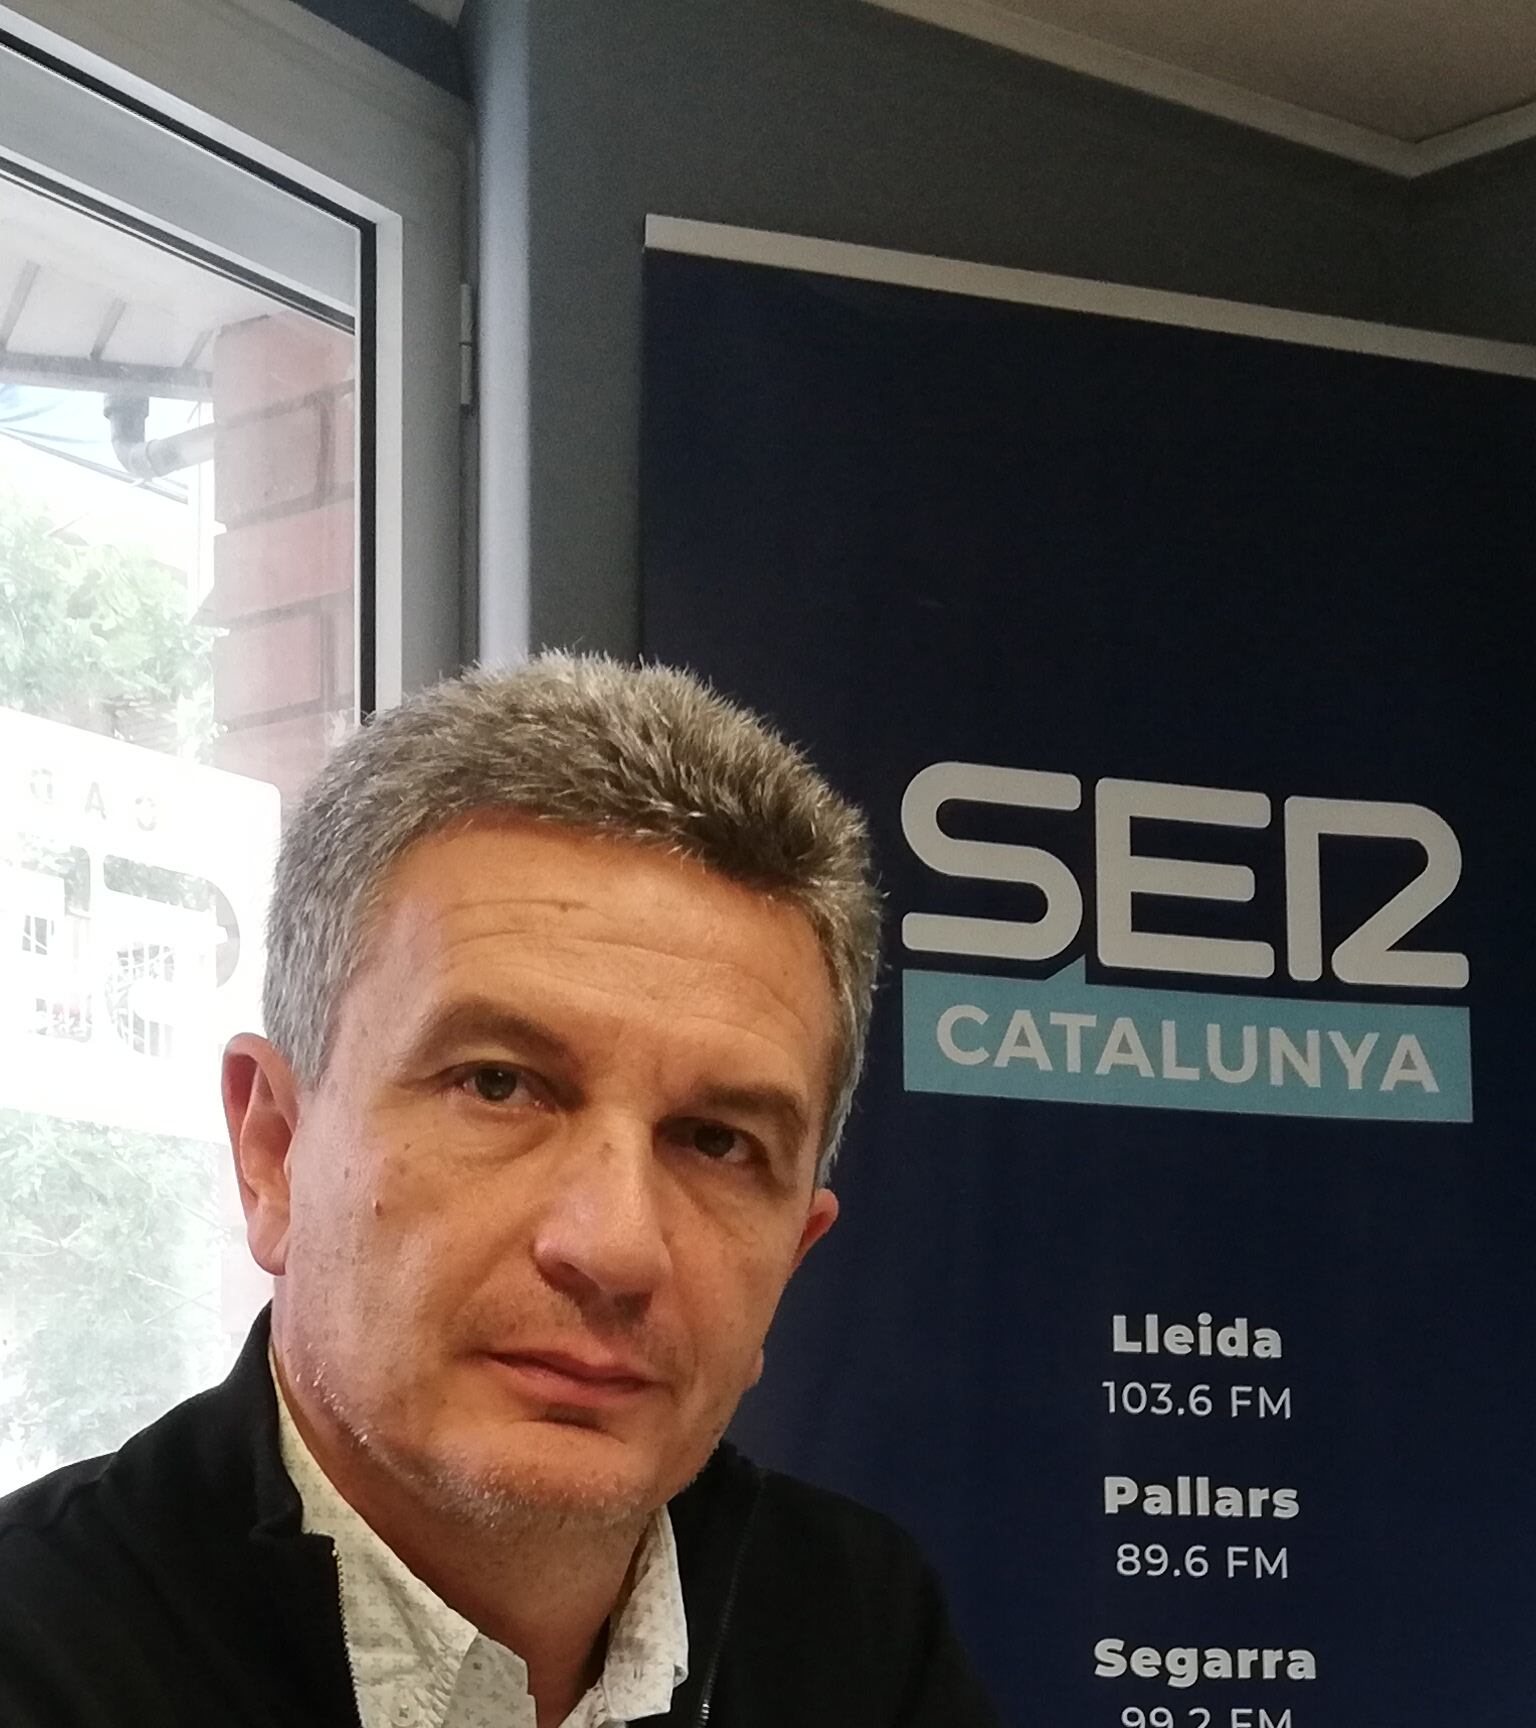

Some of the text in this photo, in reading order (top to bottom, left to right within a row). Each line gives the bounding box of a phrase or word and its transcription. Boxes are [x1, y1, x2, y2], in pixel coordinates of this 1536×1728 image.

[901, 762, 1469, 988] SER
[935, 1004, 1441, 1093] CATALUNYA
[1112, 1312, 1282, 1359] Lleida
[1102, 1380, 1291, 1419] 103.6 FM
[1104, 1475, 1300, 1519] Pallars
[1116, 1543, 1288, 1579] 89.6 FM
[1094, 1638, 1317, 1688] Segarra
